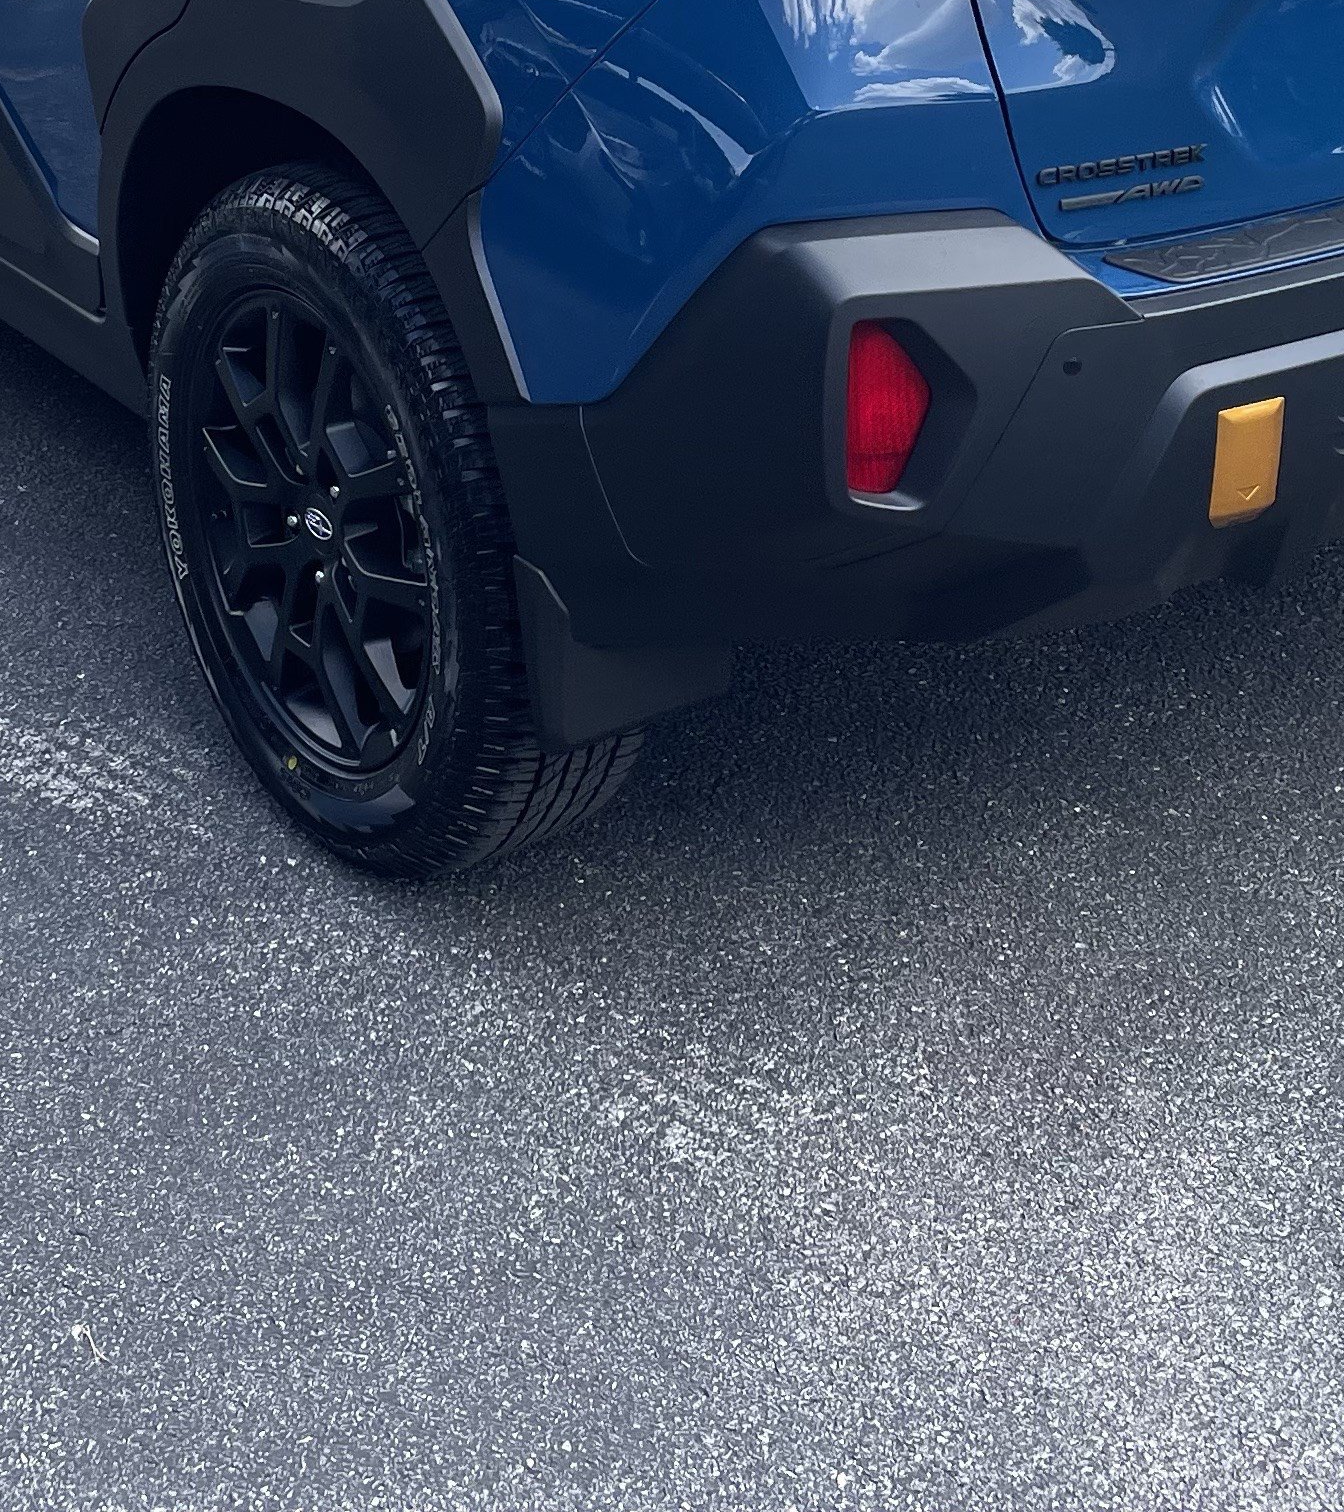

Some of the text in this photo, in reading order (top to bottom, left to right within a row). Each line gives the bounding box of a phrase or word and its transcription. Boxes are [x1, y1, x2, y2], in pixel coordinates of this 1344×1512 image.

[1036, 143, 1208, 187] CROSSTREK
[1114, 174, 1205, 204] AWD
[157, 373, 189, 580] YOKOHAMA
